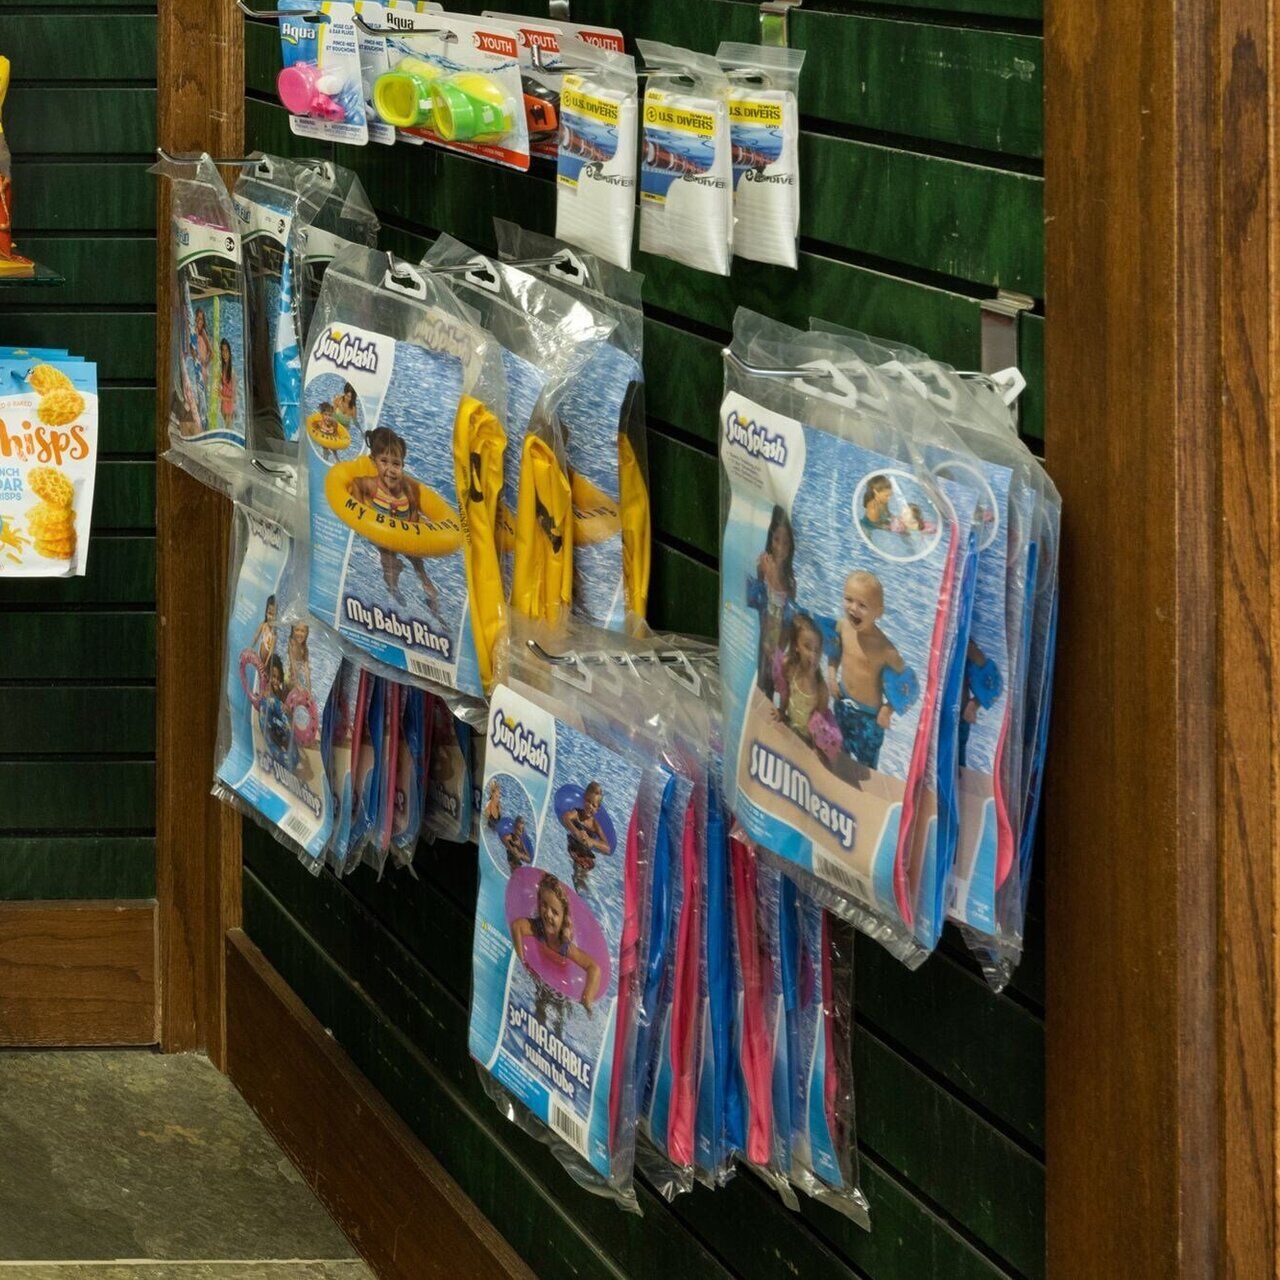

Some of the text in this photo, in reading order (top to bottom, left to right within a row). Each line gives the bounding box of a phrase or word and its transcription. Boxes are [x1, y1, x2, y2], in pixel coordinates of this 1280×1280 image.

[585, 36, 619, 51] YOUTH
[658, 107, 714, 130] U.S. DIVERS
[346, 598, 451, 656] My Baby Ring
[809, 787, 856, 850] easy
[527, 1018, 591, 1087] INFLATABLE
